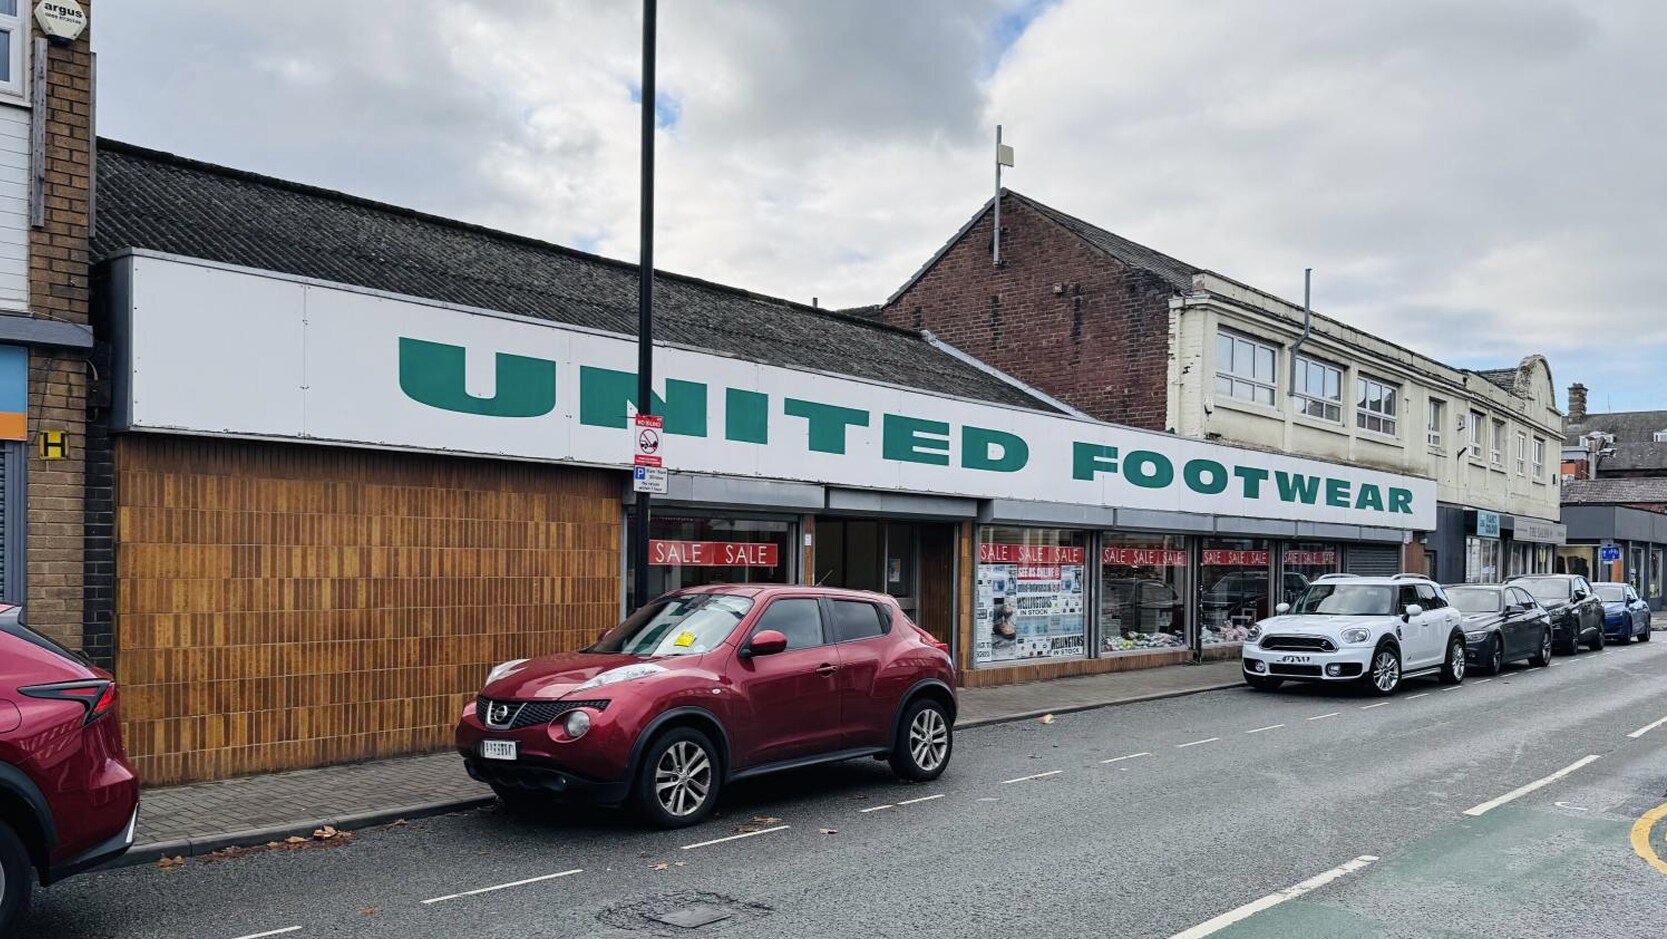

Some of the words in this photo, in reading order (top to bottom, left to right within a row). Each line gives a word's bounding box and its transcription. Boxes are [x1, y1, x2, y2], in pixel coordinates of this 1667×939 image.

[44, 2, 83, 18] argus
[399, 336, 1029, 473] UNITED
[1072, 441, 1414, 515] FOOTWEAR
[43, 432, 66, 457] H
[637, 468, 645, 479] P
[655, 542, 702, 563] SALE
[725, 544, 767, 564] SALE
[980, 544, 1008, 560] SALE
[1018, 546, 1043, 562] SALE
[1054, 546, 1078, 563] SALE
[1104, 549, 1126, 563] SALE
[1133, 550, 1154, 564] SALE
[1163, 551, 1183, 564] SALE
[1203, 551, 1221, 564] SALE
[1229, 551, 1244, 564] SALE
[1251, 552, 1267, 564] SALE
[1017, 596, 1052, 610] WELLINGTONS
[1028, 608, 1048, 616] STOCK
[1051, 635, 1084, 649] WELLINGTONS
[1061, 647, 1079, 655] STOCK
